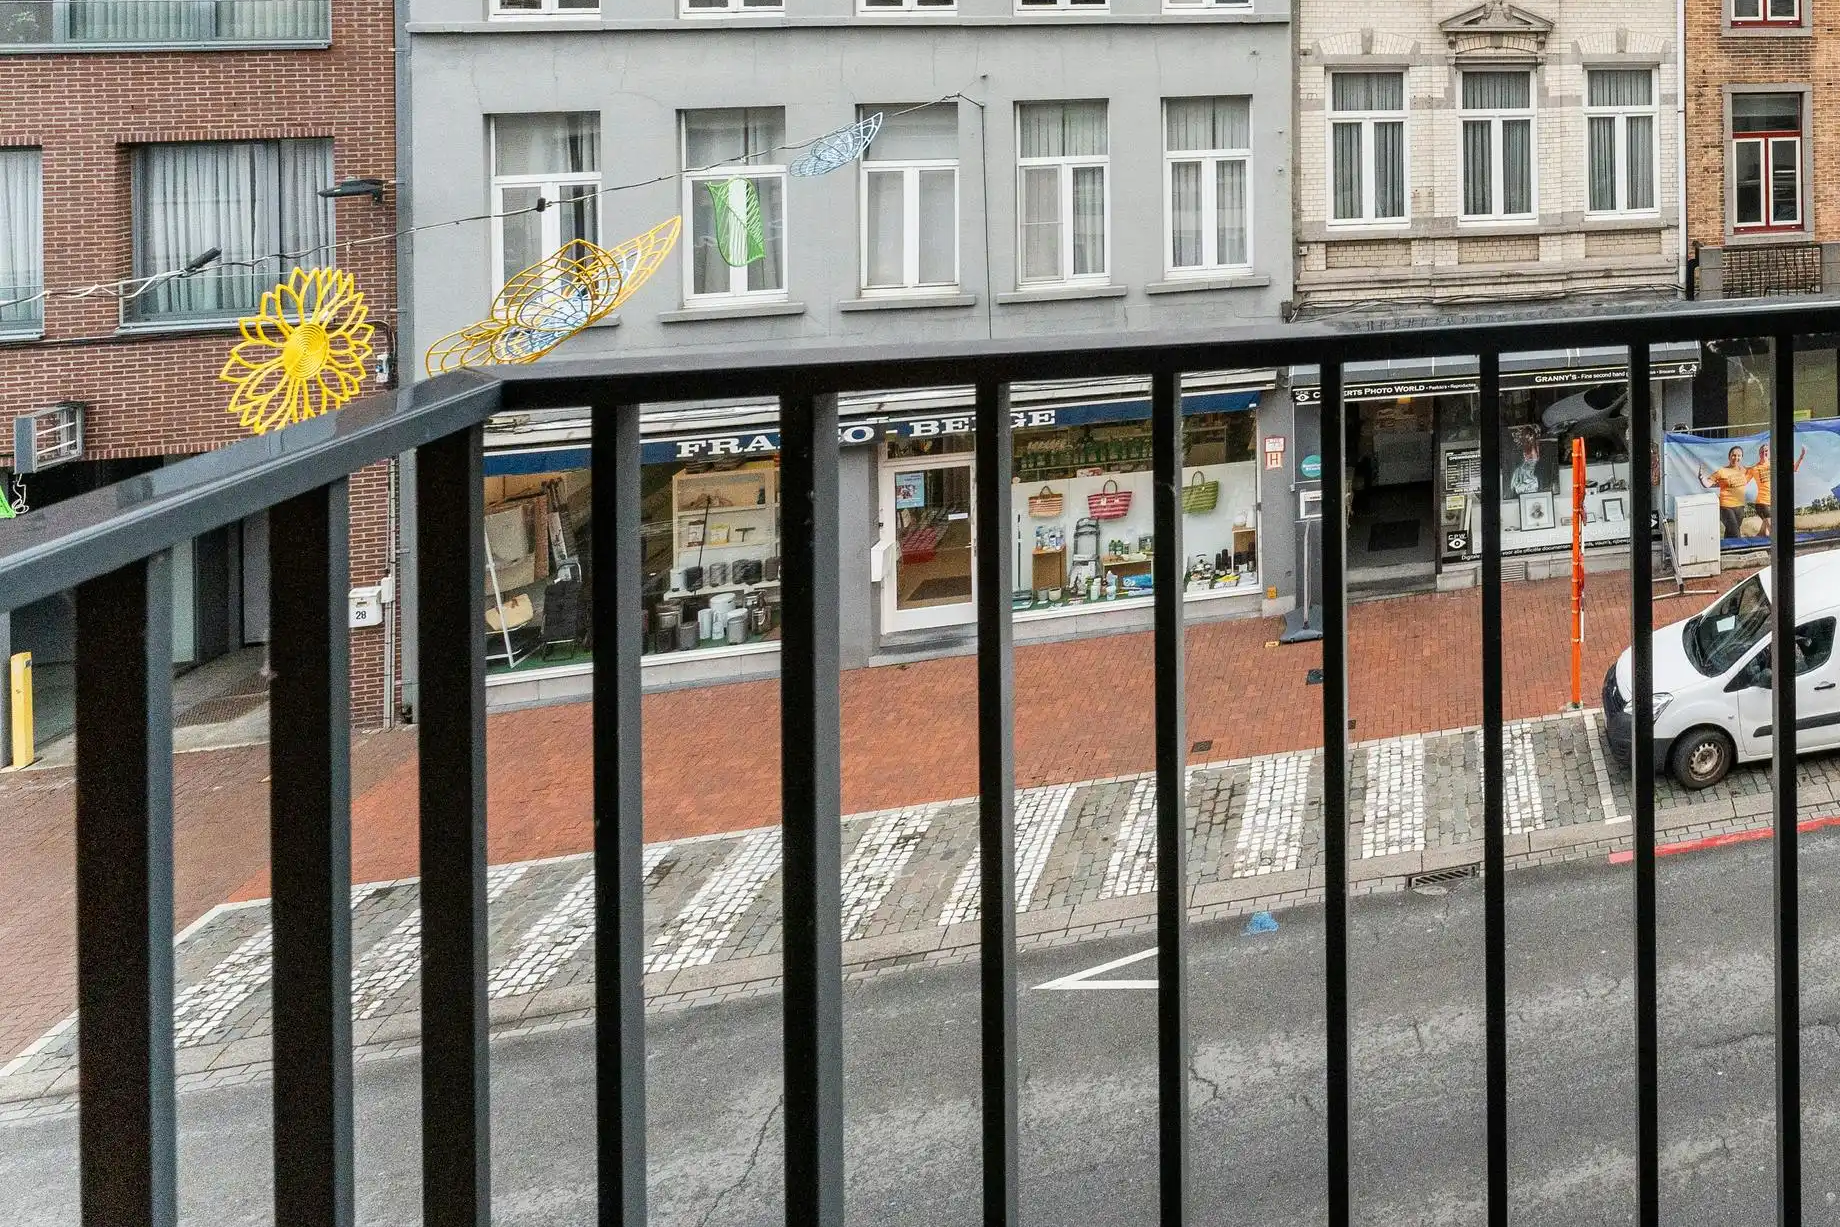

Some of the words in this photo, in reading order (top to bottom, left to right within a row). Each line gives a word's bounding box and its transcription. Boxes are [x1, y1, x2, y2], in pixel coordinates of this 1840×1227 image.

[1535, 375, 1577, 383] GRANNY'S
[909, 410, 1055, 437] BEGE
[1270, 453, 1278, 465] H
[355, 610, 367, 620] 28
